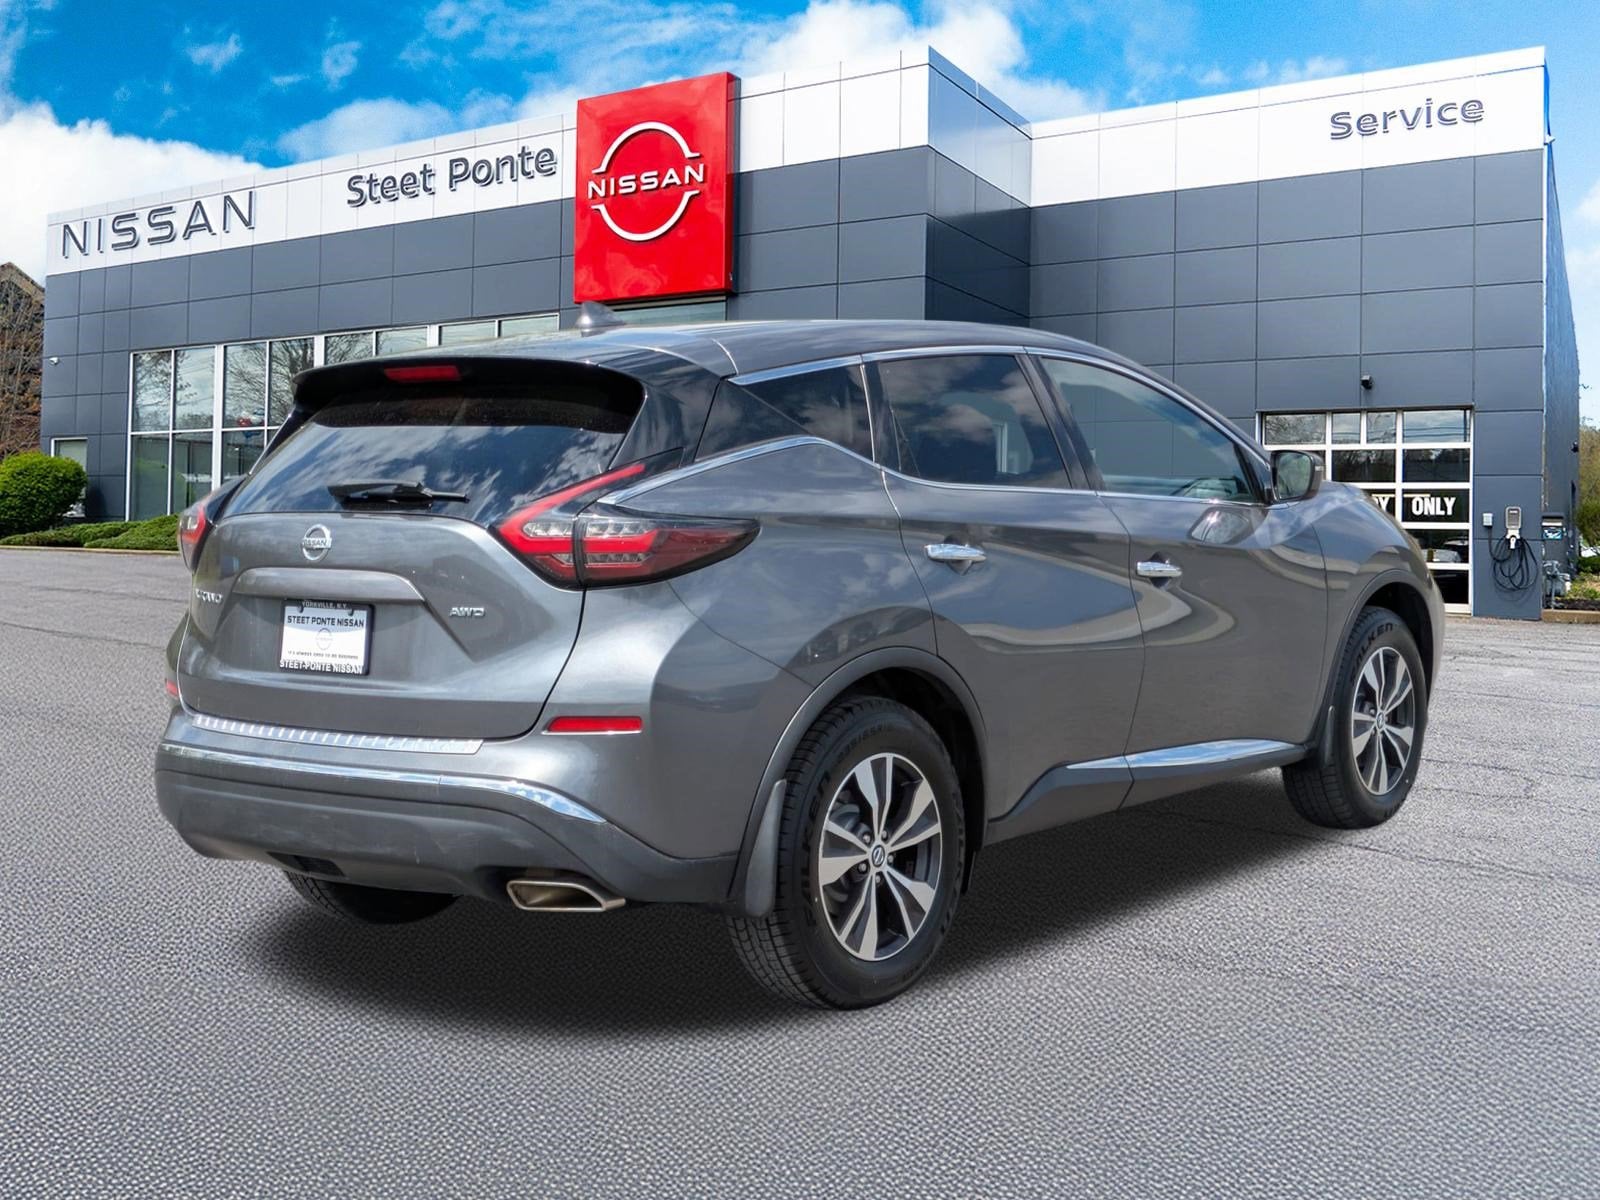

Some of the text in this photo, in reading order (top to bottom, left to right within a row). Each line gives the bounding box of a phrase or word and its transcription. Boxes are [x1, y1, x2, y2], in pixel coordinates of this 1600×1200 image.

[1330, 98, 1485, 140] Service
[347, 146, 558, 207] Steet Ponte
[587, 163, 705, 199] NISSAN
[62, 191, 256, 259] NISSAN
[1411, 496, 1456, 516] ONLY
[287, 616, 364, 628] STEET PONTE NISSAN
[449, 607, 485, 617] AWD
